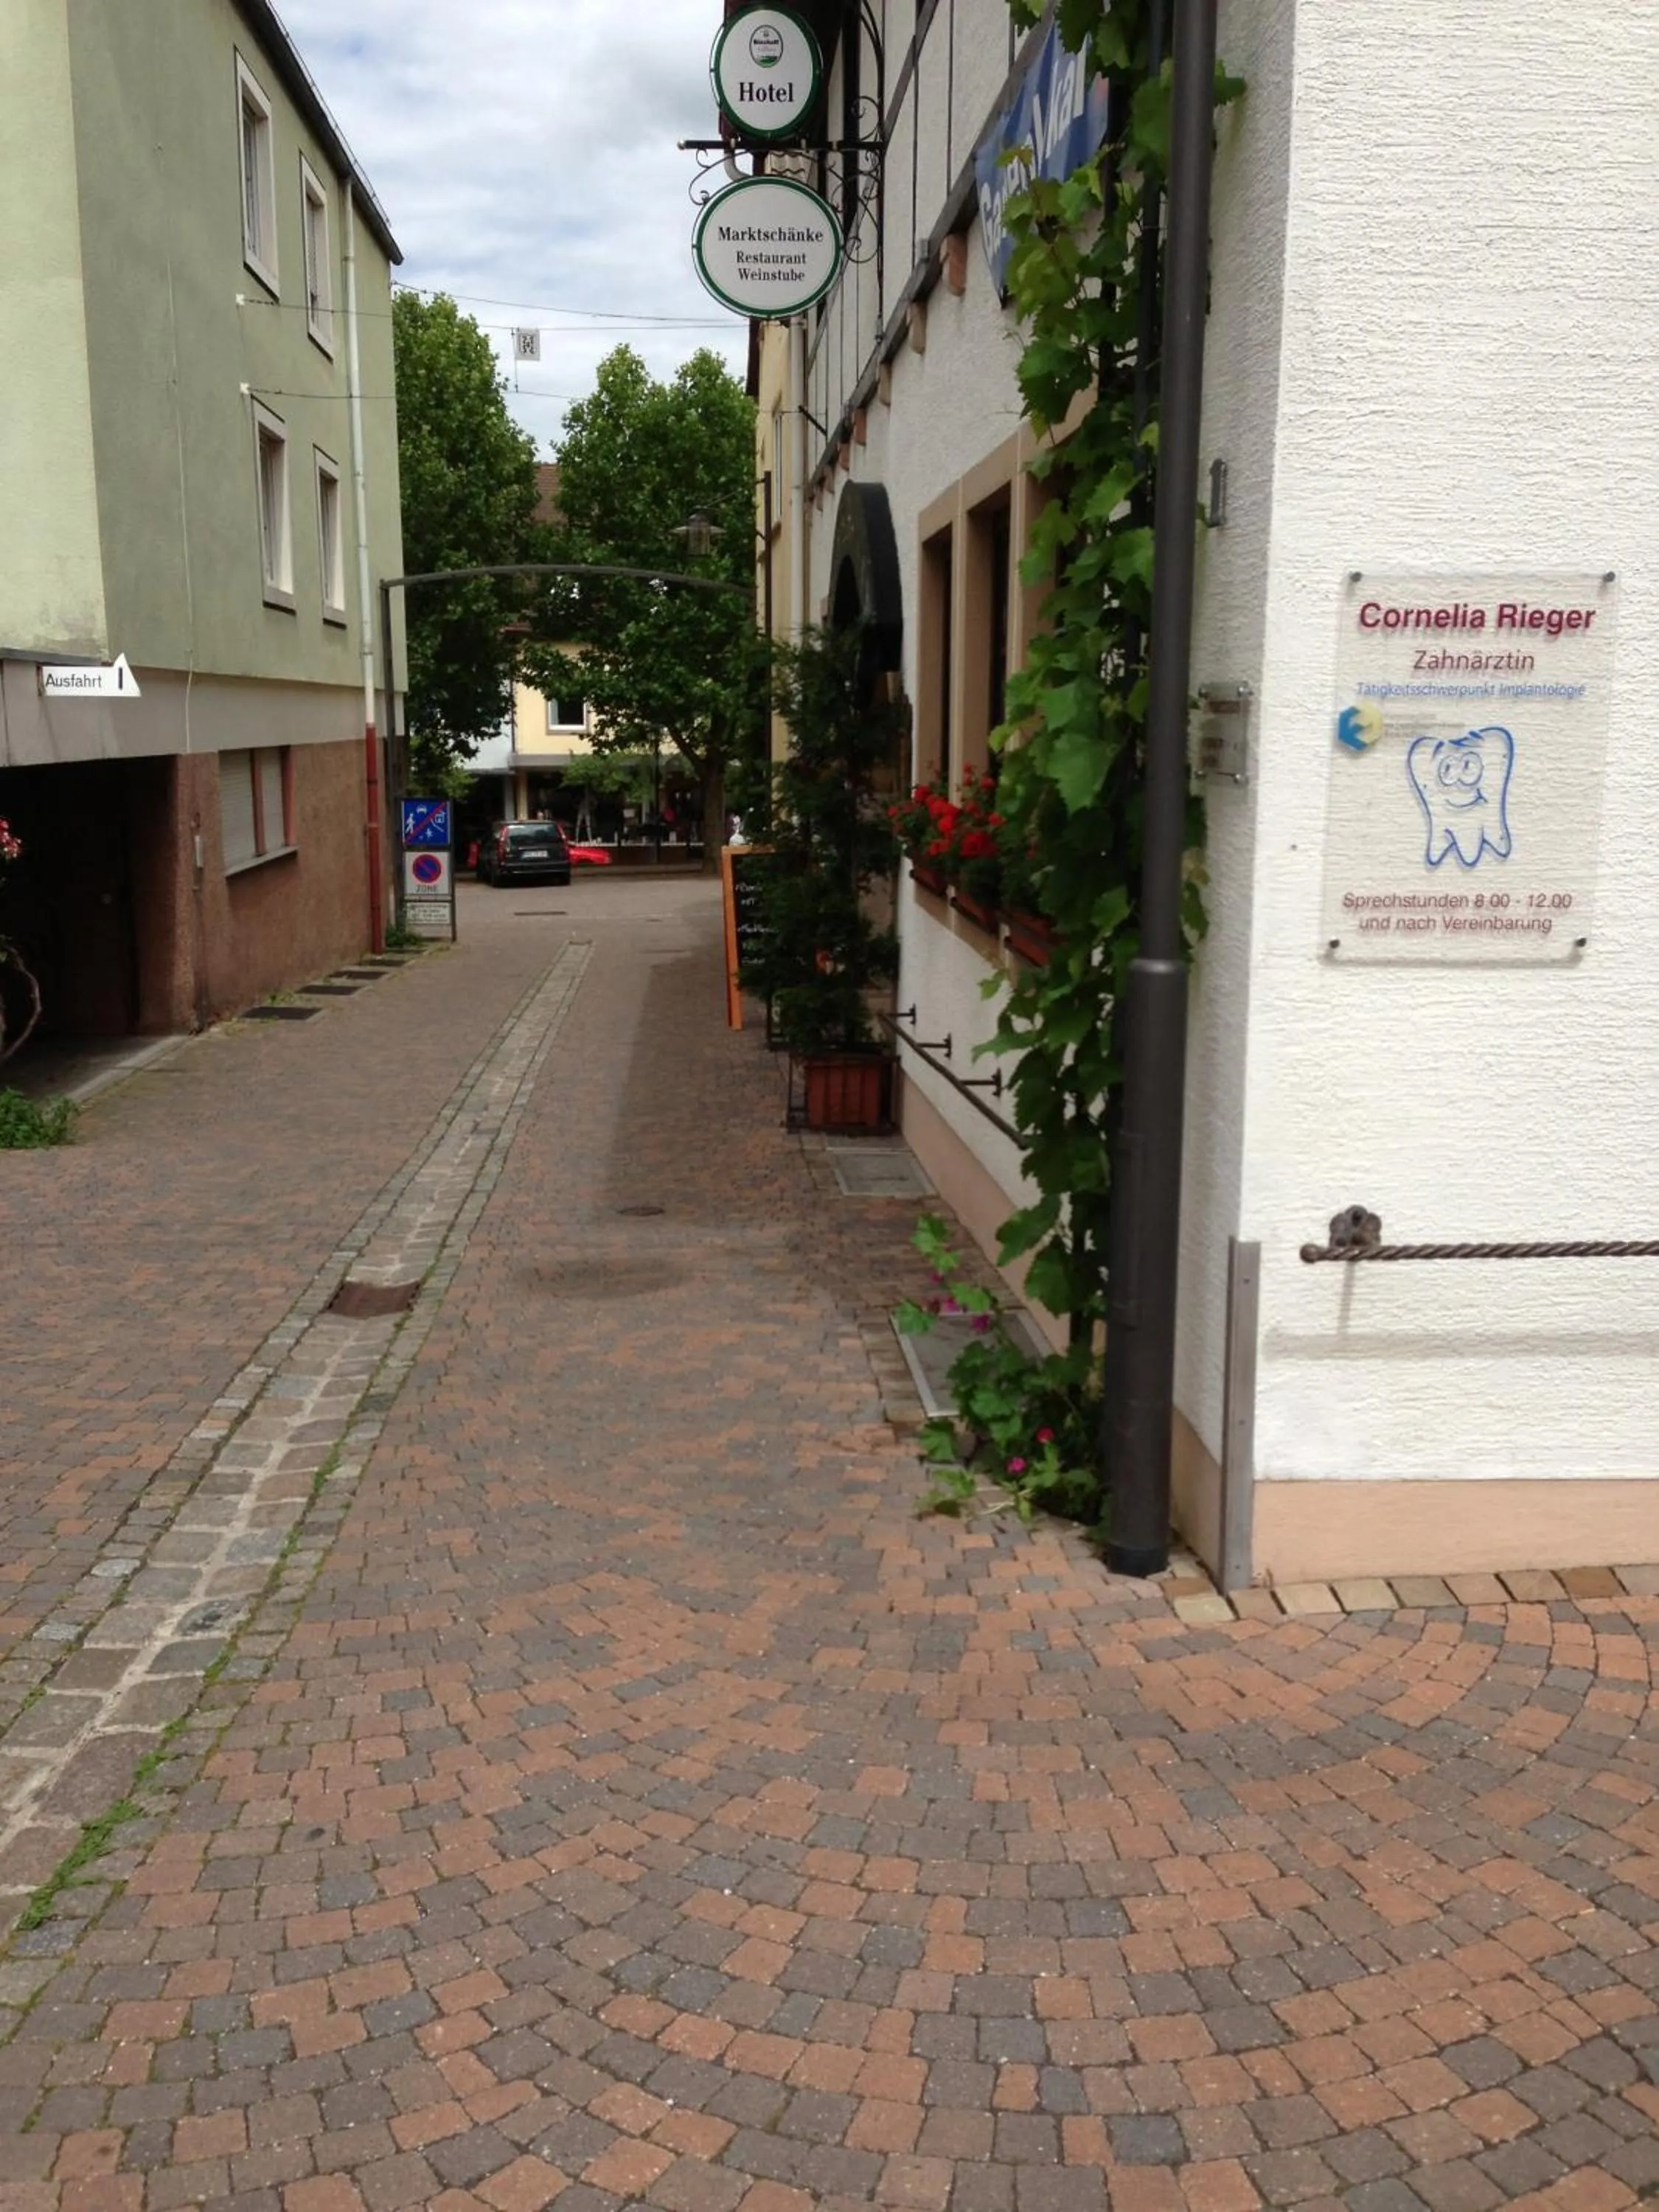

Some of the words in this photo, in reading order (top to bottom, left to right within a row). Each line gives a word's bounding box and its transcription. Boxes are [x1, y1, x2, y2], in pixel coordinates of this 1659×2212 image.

[738, 82, 794, 102] Hotel
[718, 226, 824, 243] Marktschänke
[736, 250, 807, 265] Restaurant
[737, 268, 805, 282] Weinstube
[1359, 602, 1486, 628] Cornelia
[1497, 603, 1596, 635] Rieger
[1413, 649, 1535, 671] Zahnärztin
[46, 673, 102, 688] Ausfahrt
[1342, 892, 1470, 911] Sprechstunden
[1359, 915, 1391, 931] und
[1396, 915, 1437, 931] nach
[1442, 915, 1553, 933] Vereinbarung
